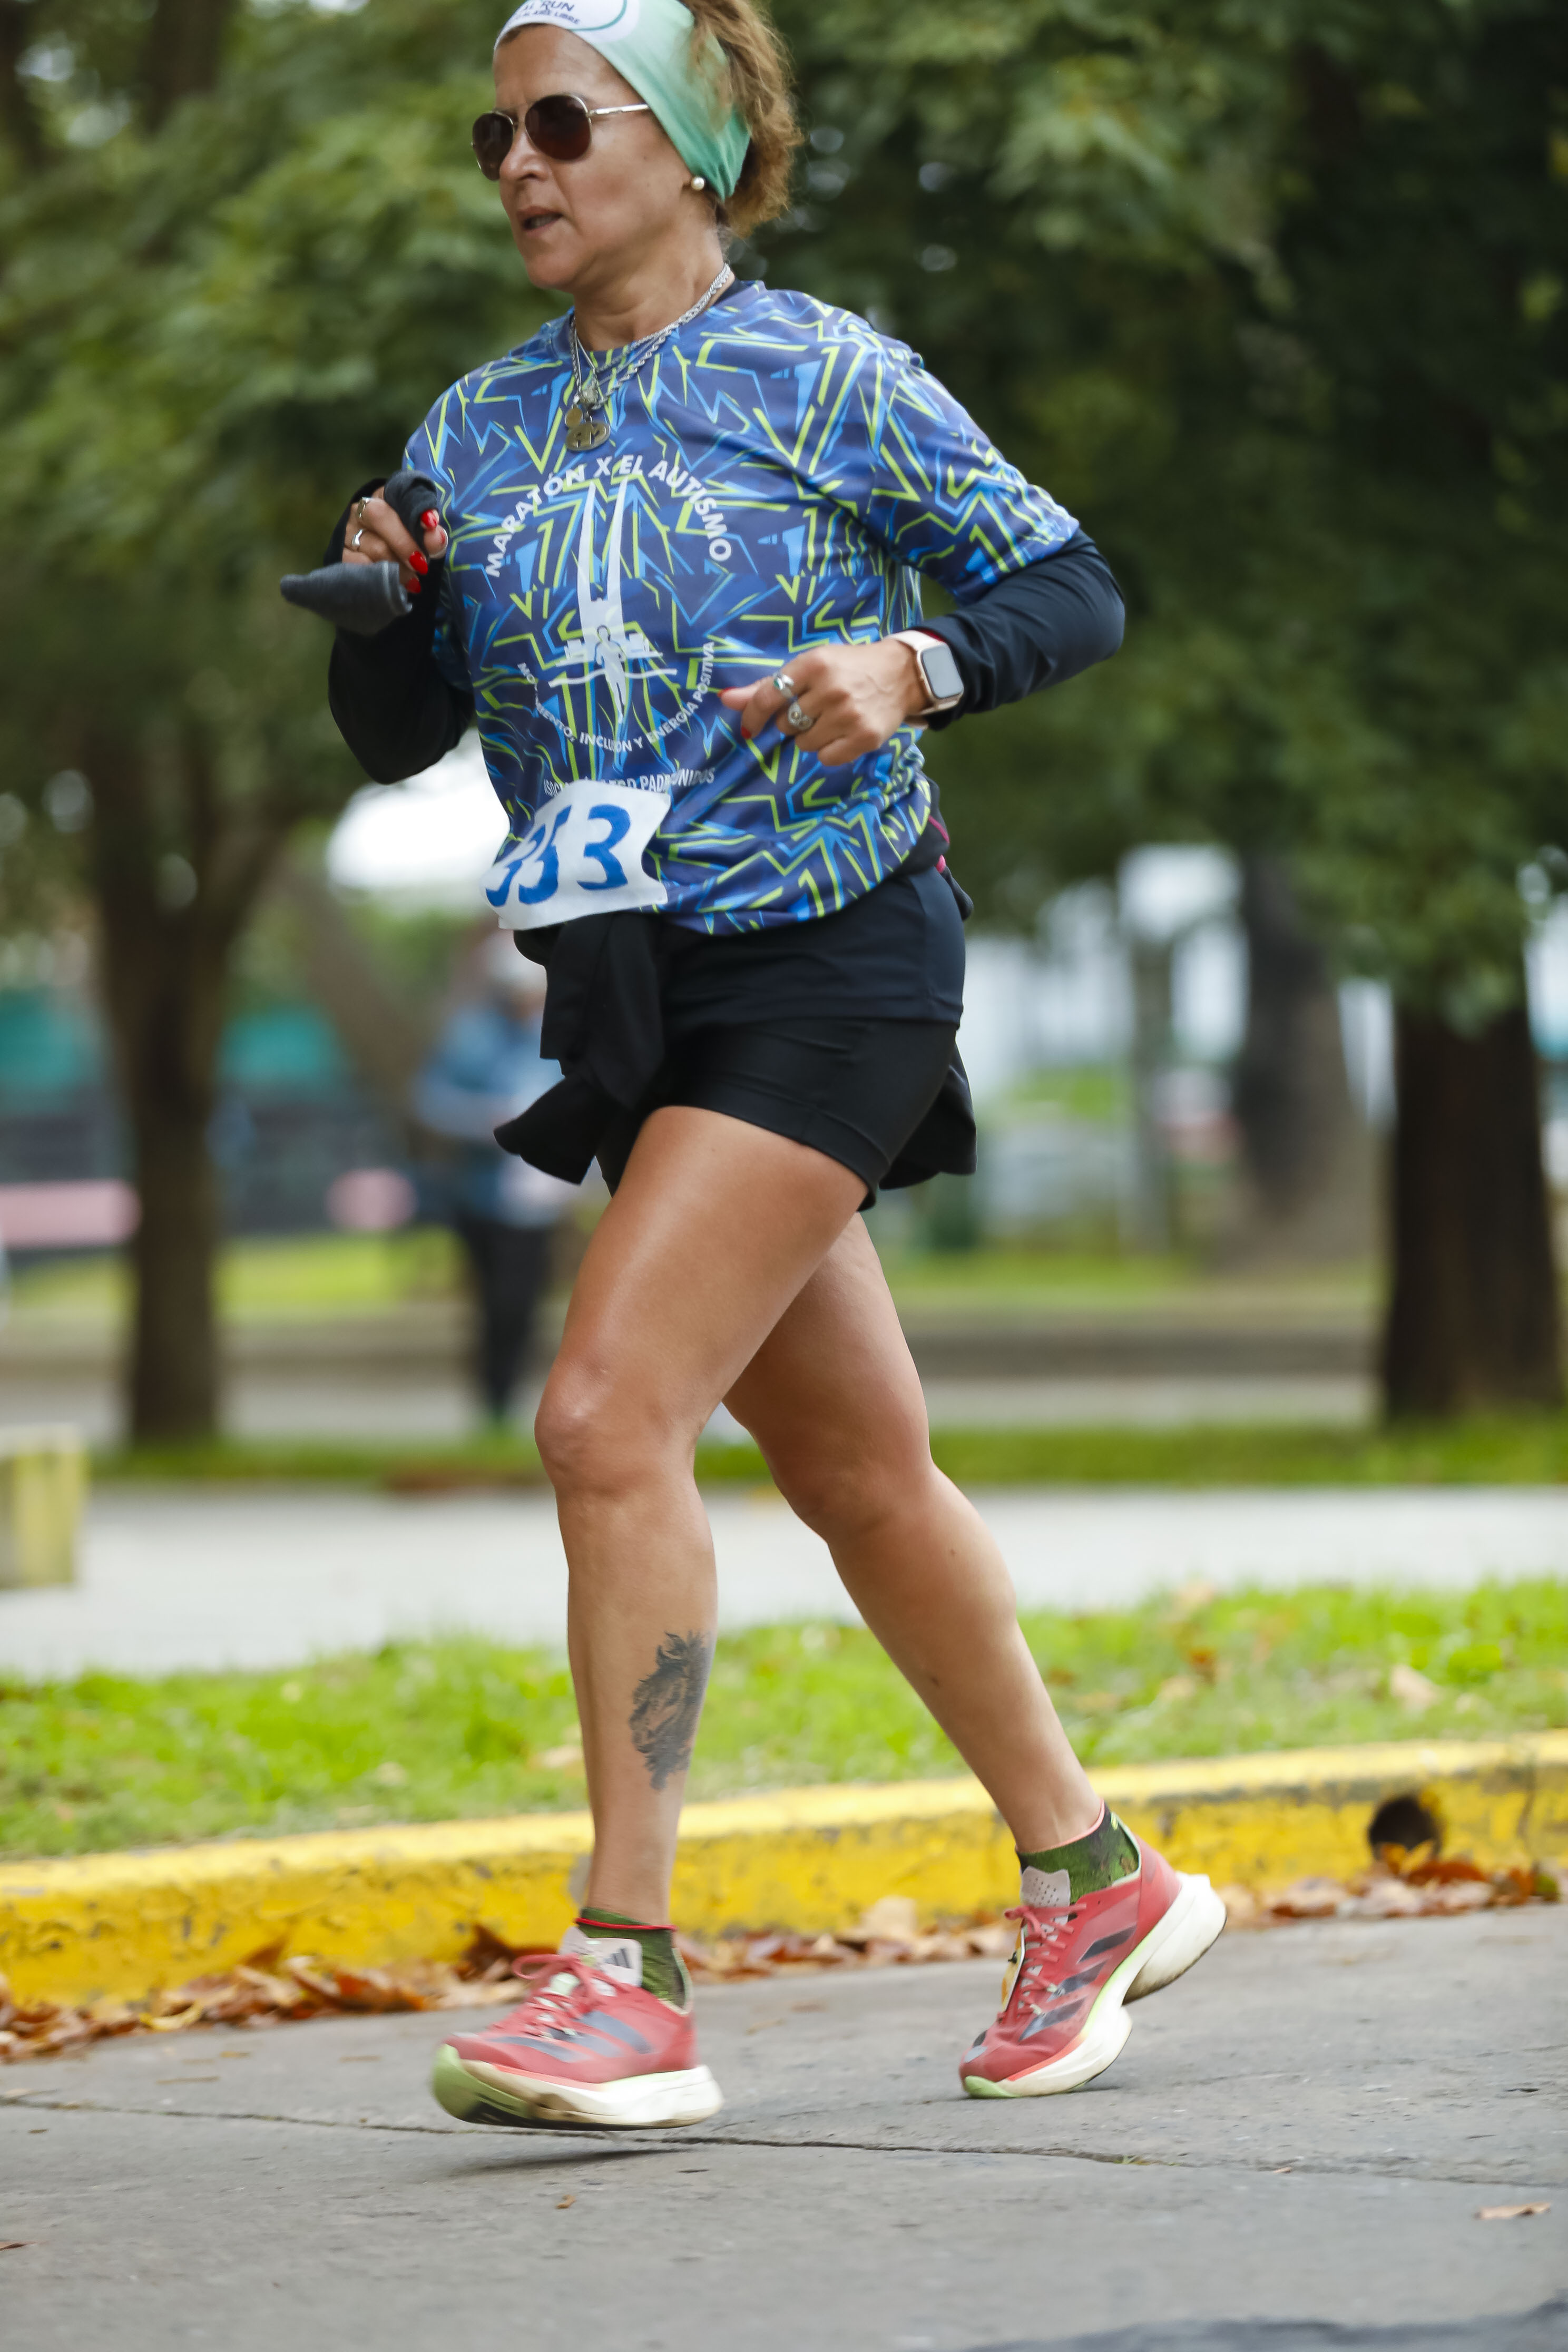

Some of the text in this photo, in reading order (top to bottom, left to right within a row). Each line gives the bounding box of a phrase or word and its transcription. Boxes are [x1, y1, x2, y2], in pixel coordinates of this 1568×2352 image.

[485, 454, 732, 577] MARATÓN X EL AUTISMO
[633, 736, 643, 749] Y
[692, 641, 714, 702] POSITIVA
